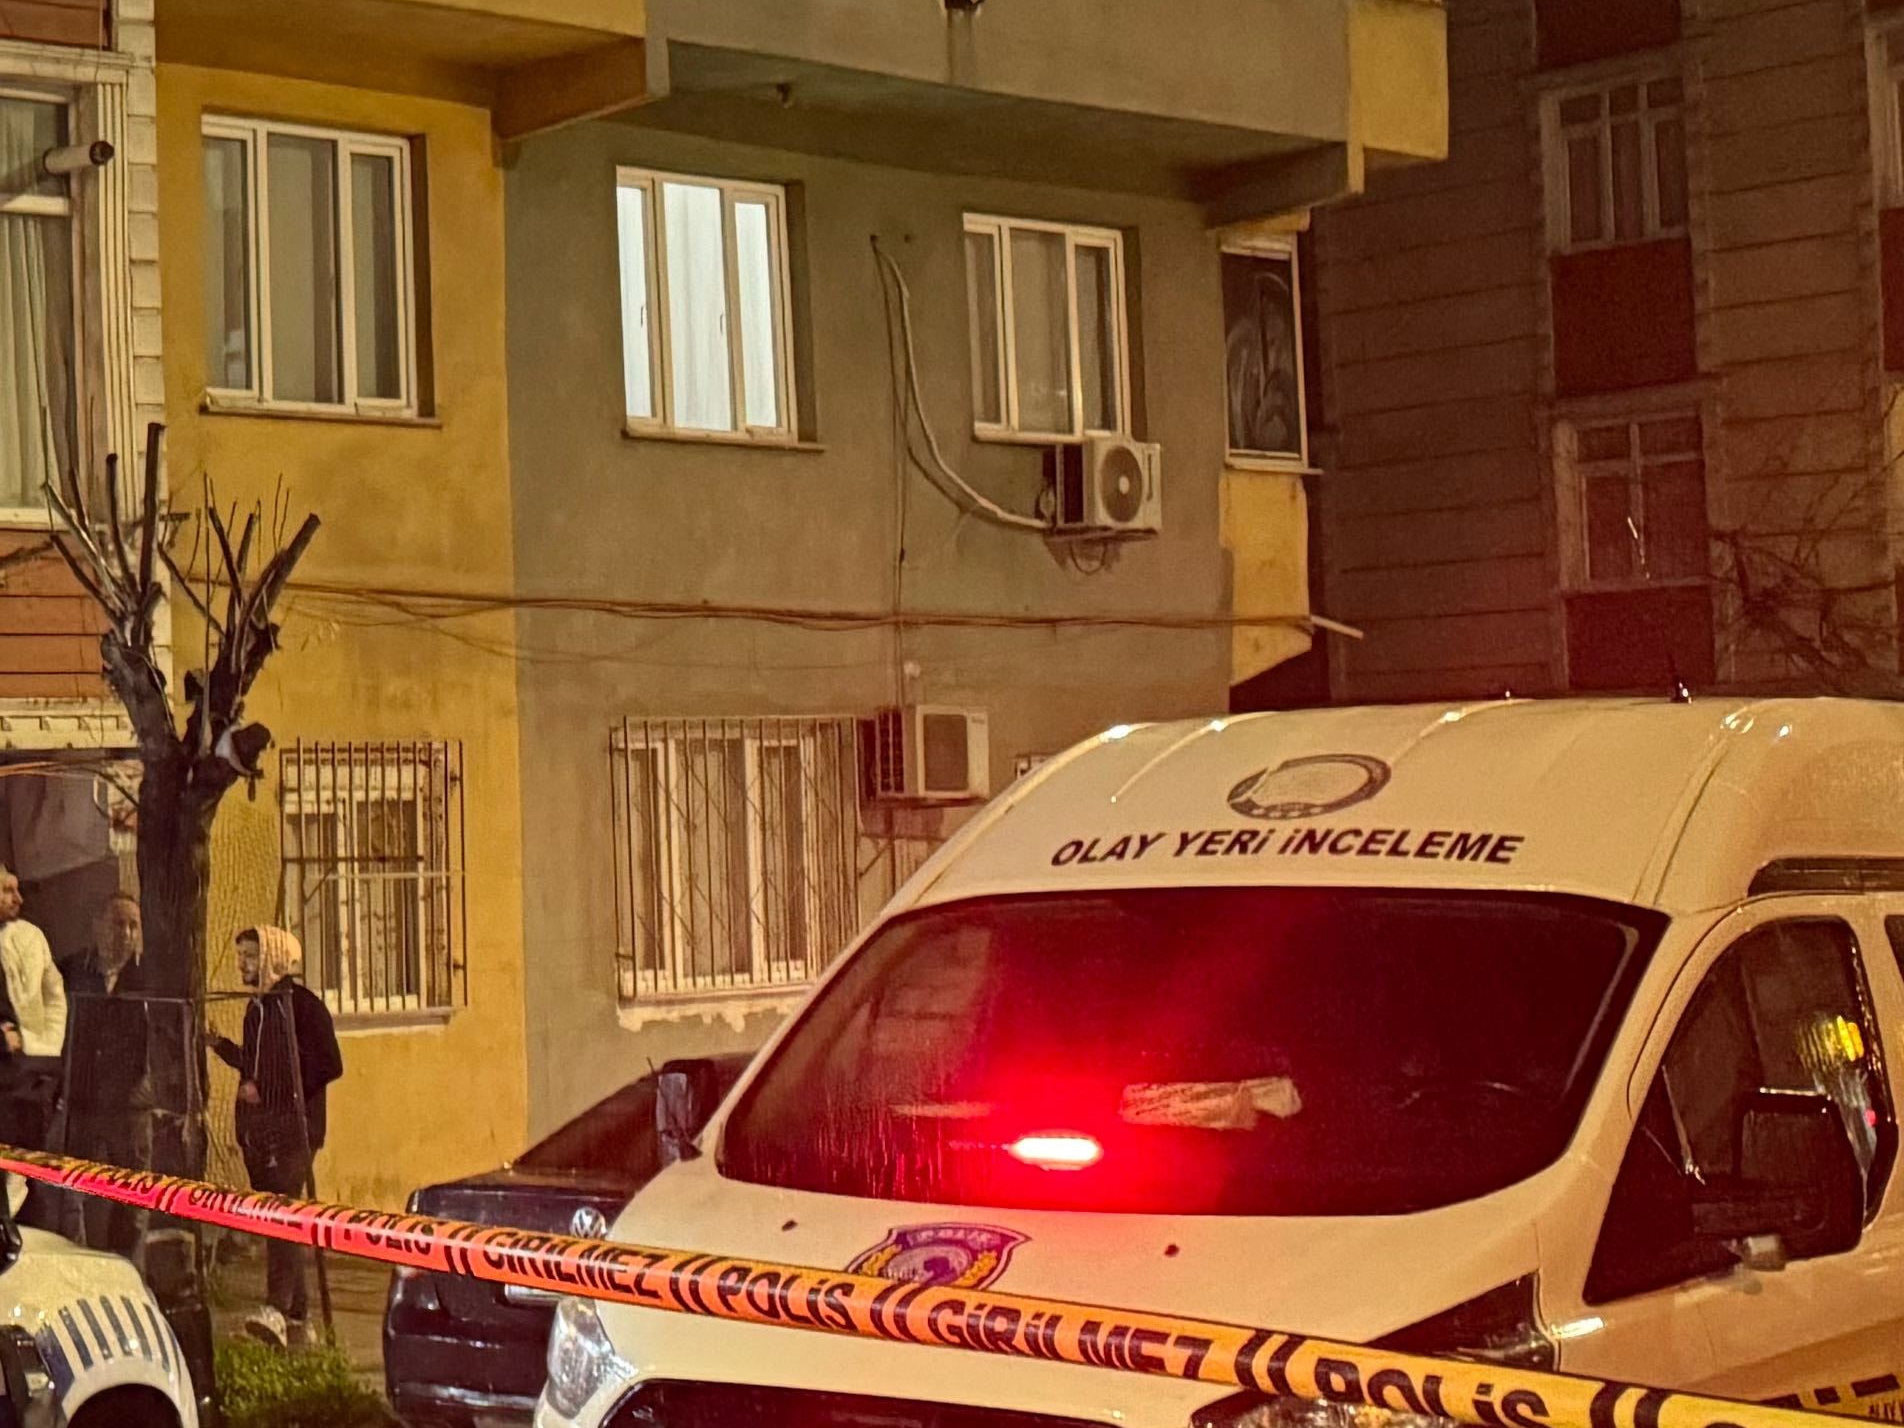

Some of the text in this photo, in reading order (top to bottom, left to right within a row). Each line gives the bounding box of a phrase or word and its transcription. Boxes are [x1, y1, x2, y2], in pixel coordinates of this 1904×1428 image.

[1051, 831, 1167, 866] OLAY
[482, 1228, 664, 1300] GİRİLMEZ
[717, 1263, 855, 1332] POLİS
[930, 1288, 1215, 1380] GİRİLMEZ
